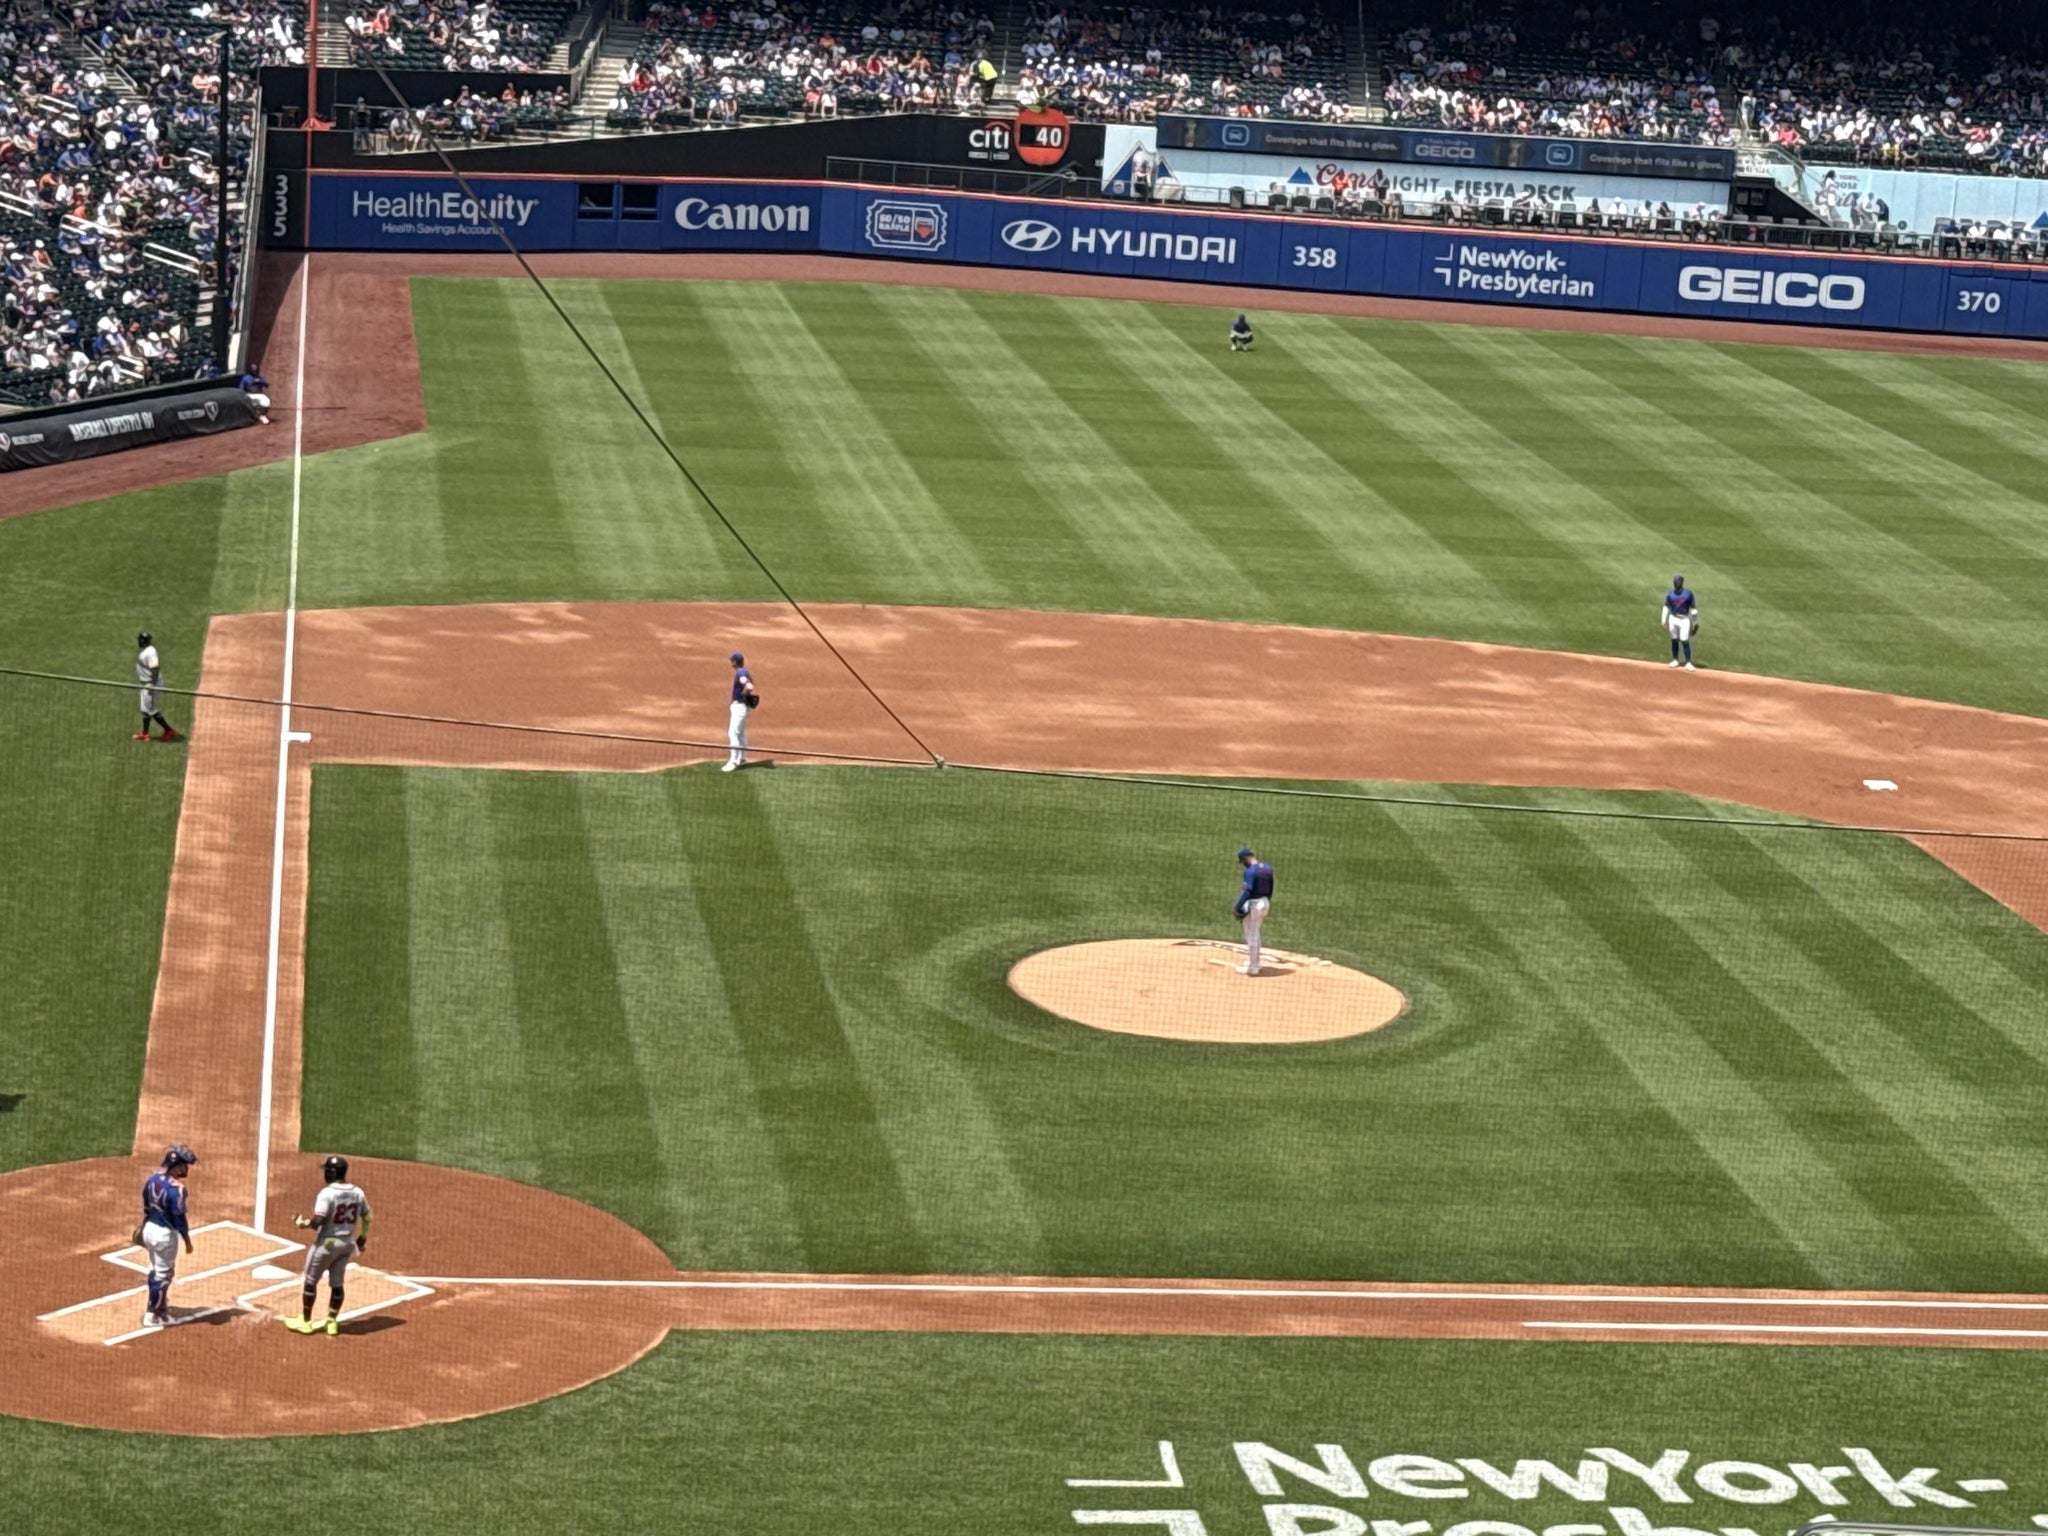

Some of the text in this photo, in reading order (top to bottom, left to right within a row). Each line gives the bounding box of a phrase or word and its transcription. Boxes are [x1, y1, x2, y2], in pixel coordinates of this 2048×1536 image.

[969, 126, 1010, 149] citi
[1036, 127, 1062, 147] 40
[1265, 134, 1308, 145] Coverage
[1309, 138, 1328, 146] that
[1415, 145, 1475, 159] GEICO
[1589, 153, 1632, 165] Coverage
[1634, 157, 1653, 166] that
[1391, 175, 1440, 193] IGHT
[1454, 180, 1516, 198] FIESTA
[1524, 184, 1576, 201] DECK
[273, 174, 289, 237] 335
[352, 190, 534, 227] HealthEquity
[675, 198, 810, 231] Canon
[382, 223, 416, 234] Health
[417, 223, 455, 235] Savings
[1072, 227, 1236, 264] HYUNDAI
[1293, 246, 1337, 268] 358
[1460, 246, 1567, 272] NewYork-
[1458, 268, 1594, 298] Presbyterian
[1678, 266, 1865, 310] GEICO
[1957, 291, 2001, 314] 370
[334, 1203, 358, 1225] 23
[1233, 1442, 2010, 1508] NewYork-
